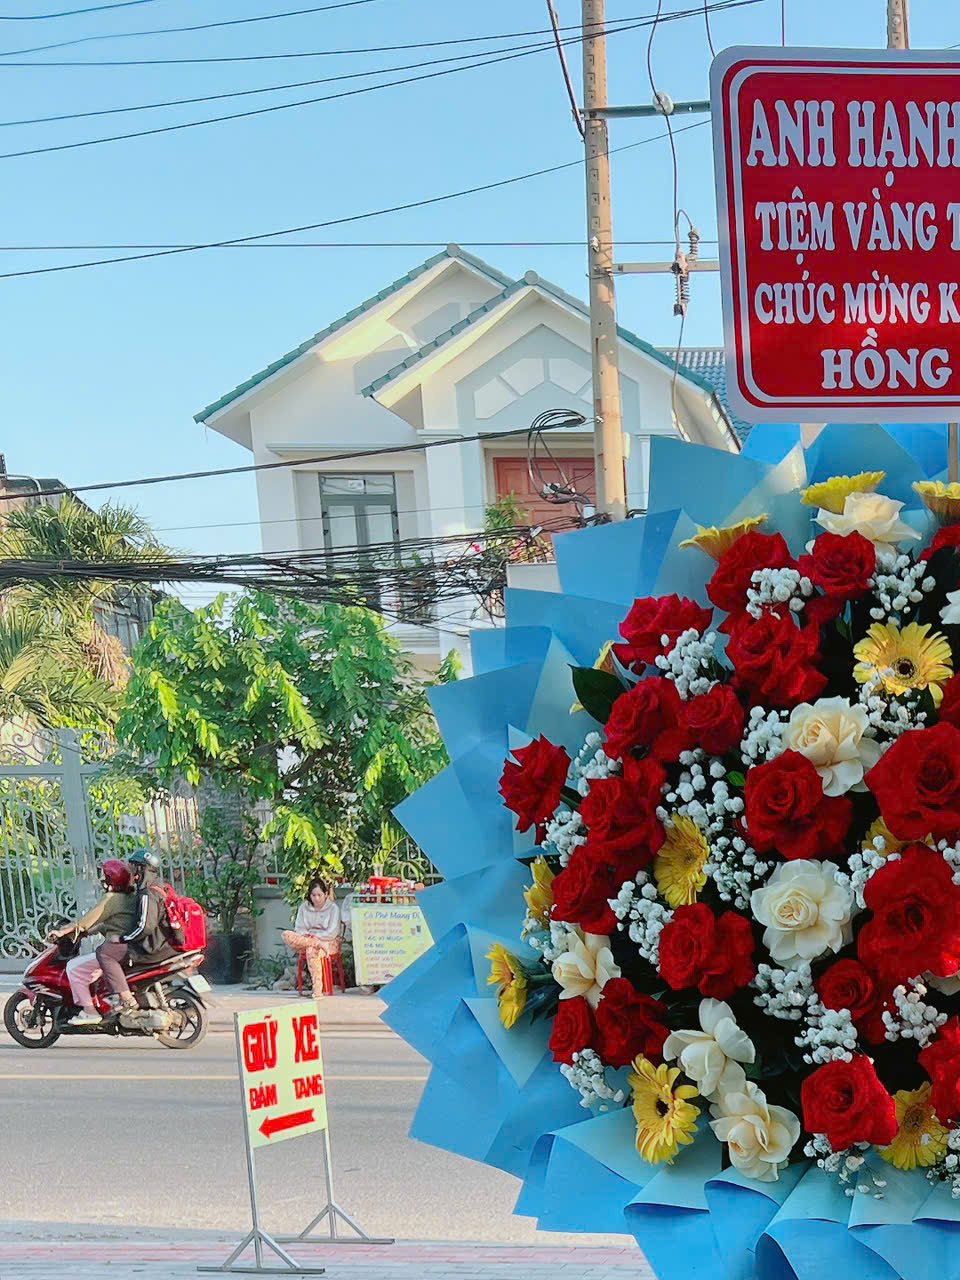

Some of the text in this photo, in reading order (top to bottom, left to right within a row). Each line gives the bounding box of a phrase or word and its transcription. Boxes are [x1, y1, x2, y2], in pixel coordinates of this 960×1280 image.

[747, 98, 837, 167] ANH
[755, 186, 835, 265] TIỆM
[843, 187, 938, 251] VÀNG
[755, 270, 835, 324] CHÚC
[843, 270, 930, 324] MỪNG
[821, 327, 953, 389] HỒNG
[243, 1014, 319, 1072] GIỮ XE
[292, 1073, 323, 1100] TANG
